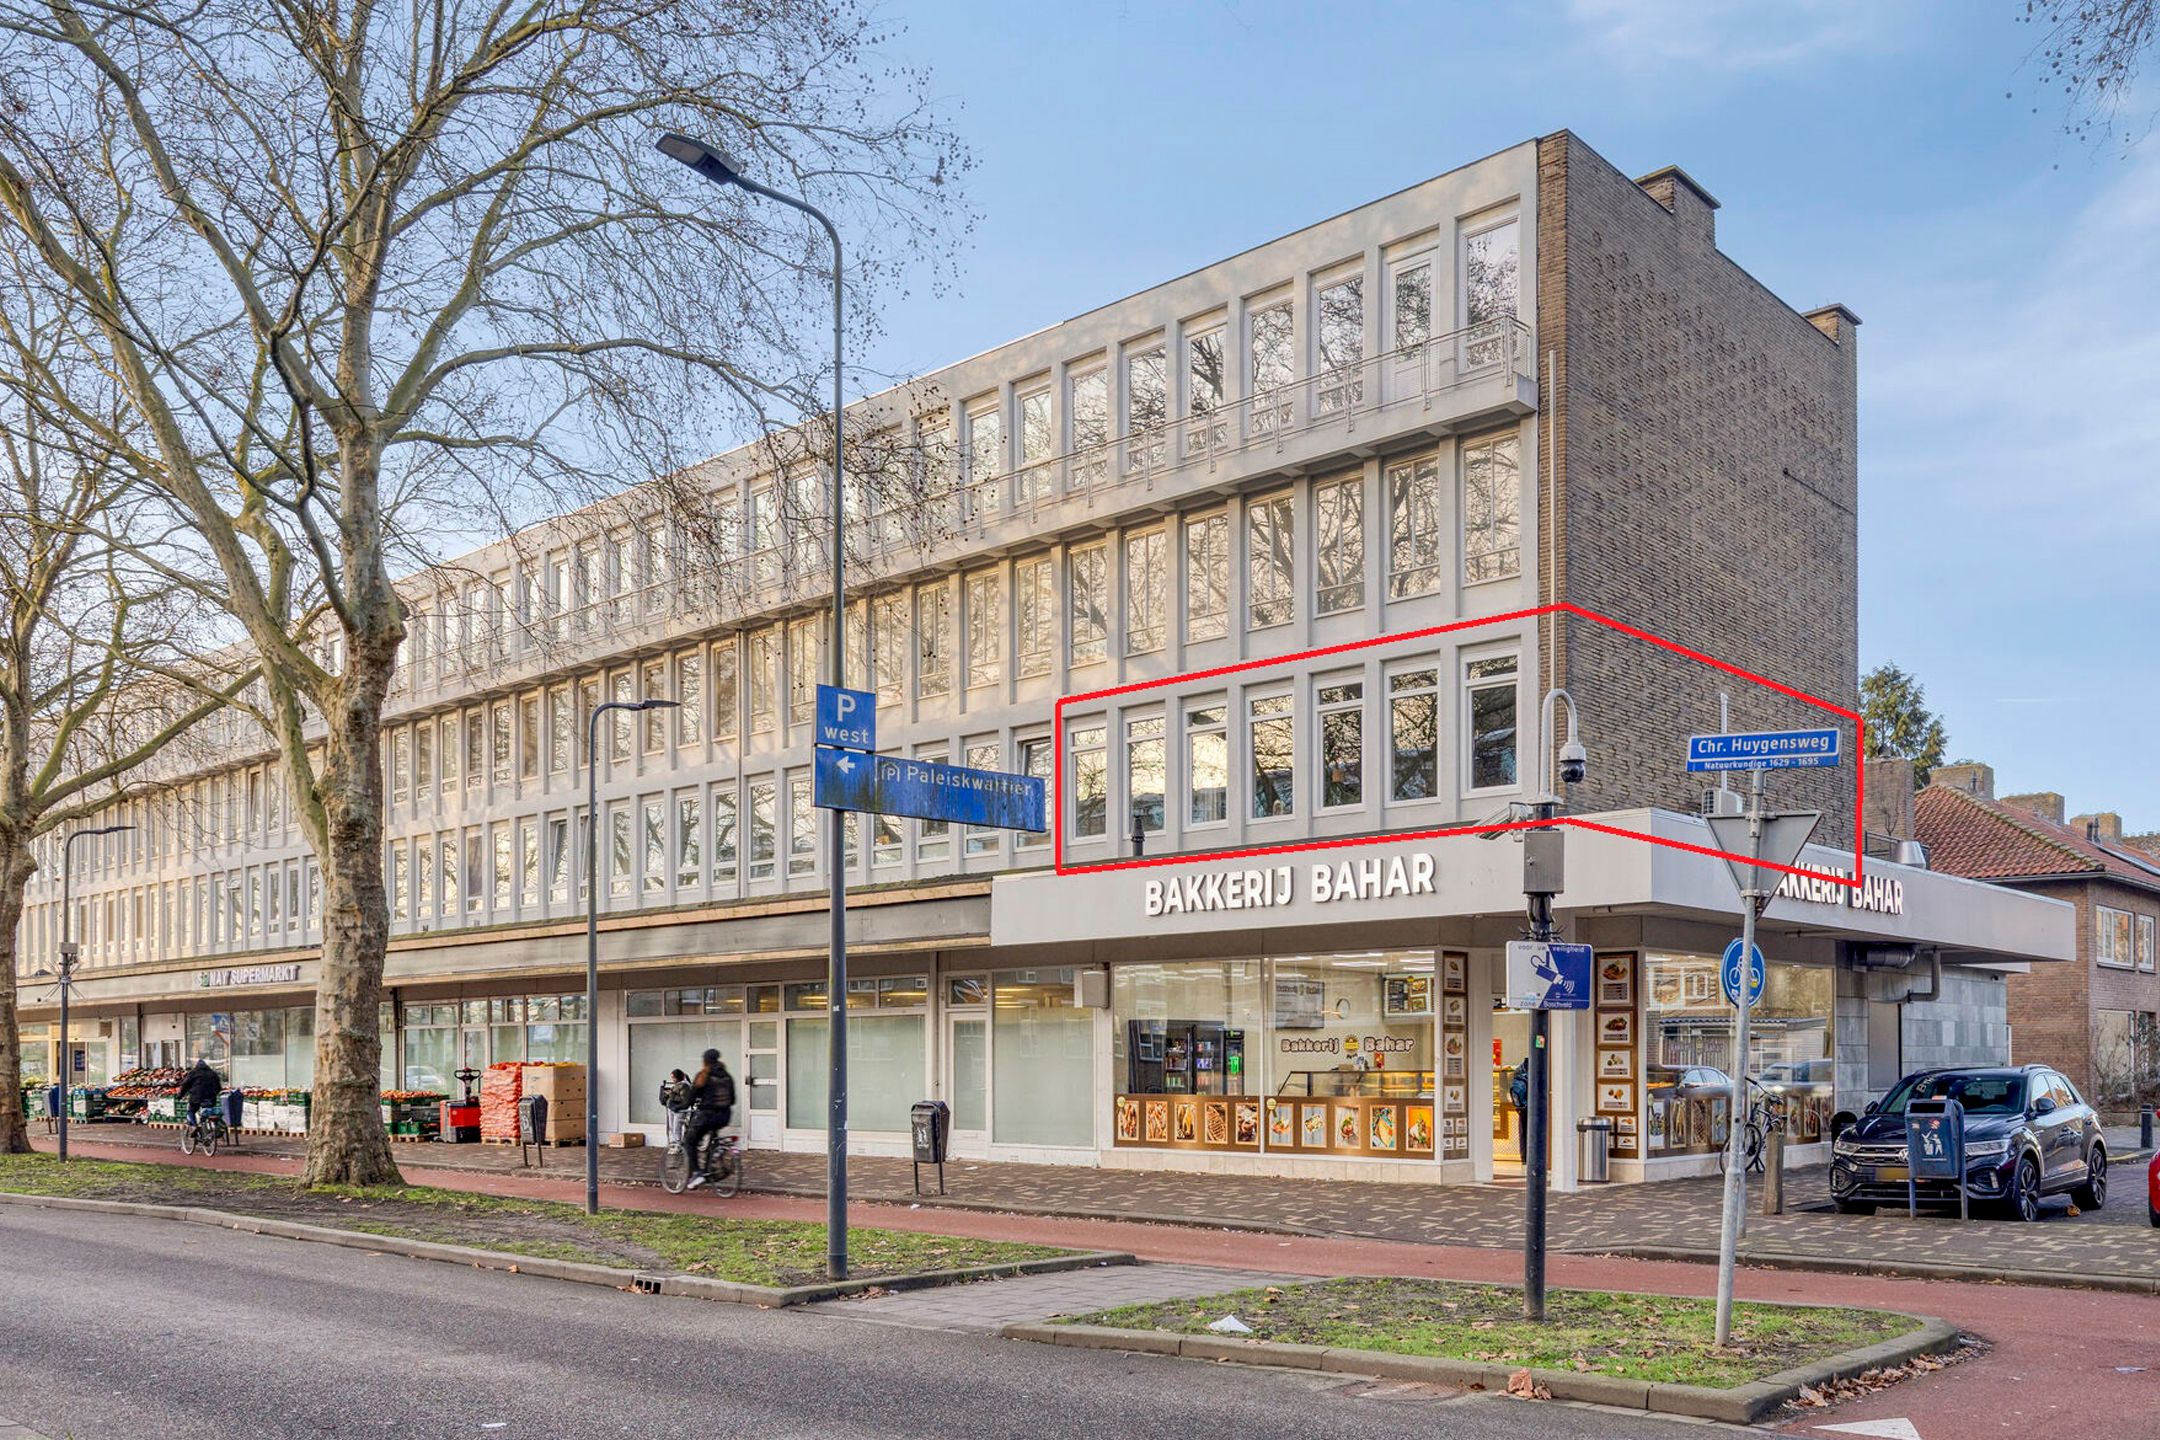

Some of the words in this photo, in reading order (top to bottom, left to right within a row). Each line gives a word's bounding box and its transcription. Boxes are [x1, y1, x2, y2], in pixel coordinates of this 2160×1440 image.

[836, 693, 856, 722] P
[824, 726, 869, 744] west
[1698, 740, 1727, 753] Chr.
[1731, 736, 1829, 754] Huygensweg
[1704, 759, 1767, 770] Natuurkundige
[1769, 758, 1790, 767] 1629
[1798, 756, 1819, 766] 1695
[1145, 866, 1295, 916] BAKKERIJ
[1311, 853, 1435, 902] BAHAR
[1775, 860, 1846, 905] AKKERIJ
[1851, 871, 1904, 915] BAHAR
[230, 965, 299, 984] SUPERMARKT
[1363, 1035, 1414, 1053] Bahar
